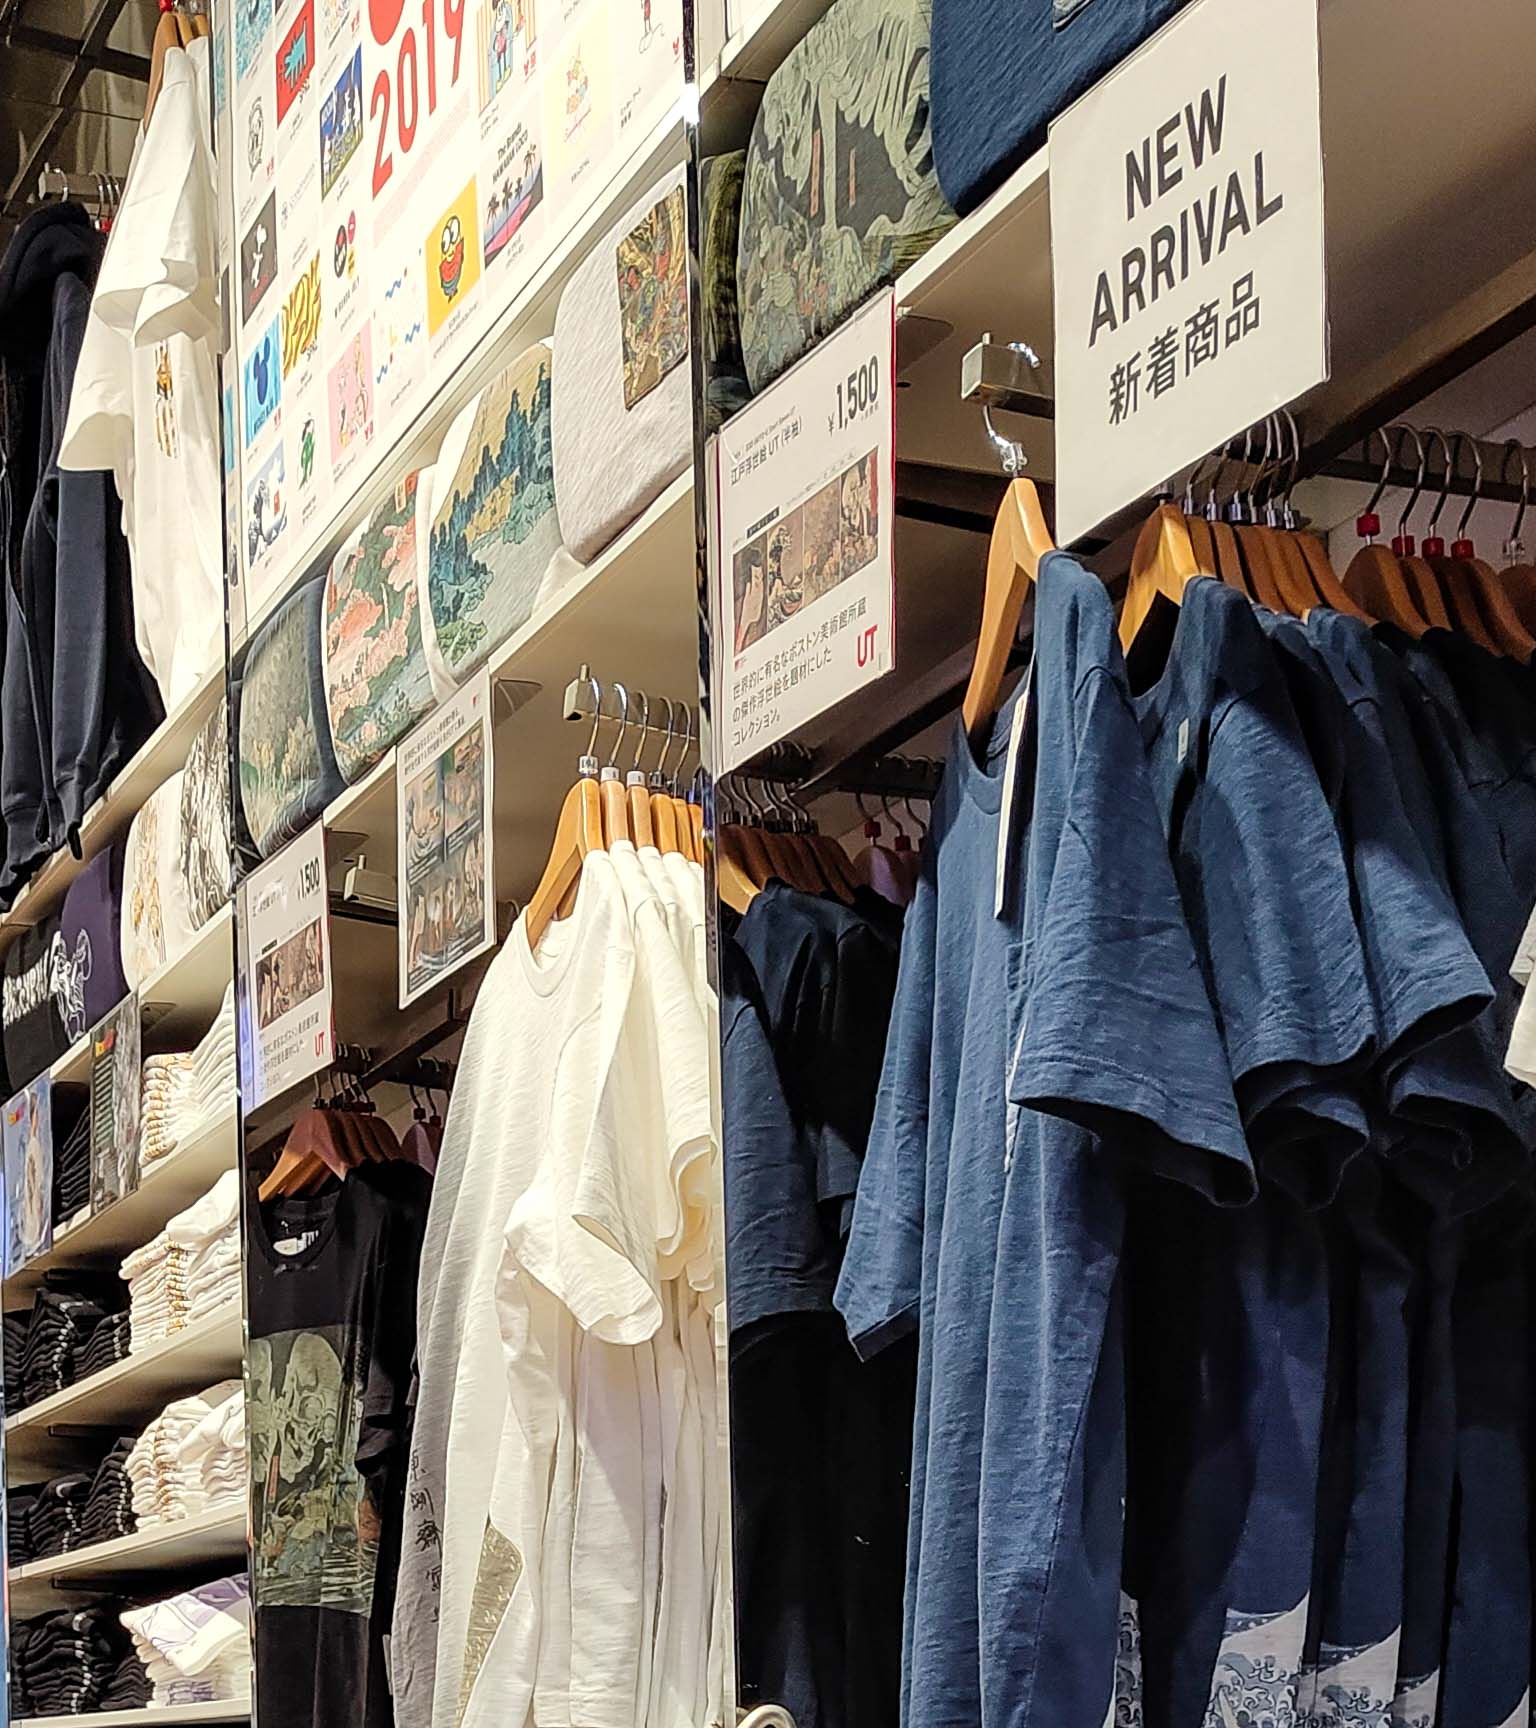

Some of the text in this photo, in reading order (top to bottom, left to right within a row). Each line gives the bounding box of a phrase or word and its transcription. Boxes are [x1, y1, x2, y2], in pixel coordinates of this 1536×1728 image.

[370, 0, 464, 201] 2019
[1124, 73, 1227, 222] NEW
[1089, 150, 1284, 349] ARRIVAL
[827, 355, 879, 436] ¥1,500
[1108, 270, 1261, 426] 新着商品
[857, 624, 878, 668] UT
[314, 1031, 325, 1058] UT
